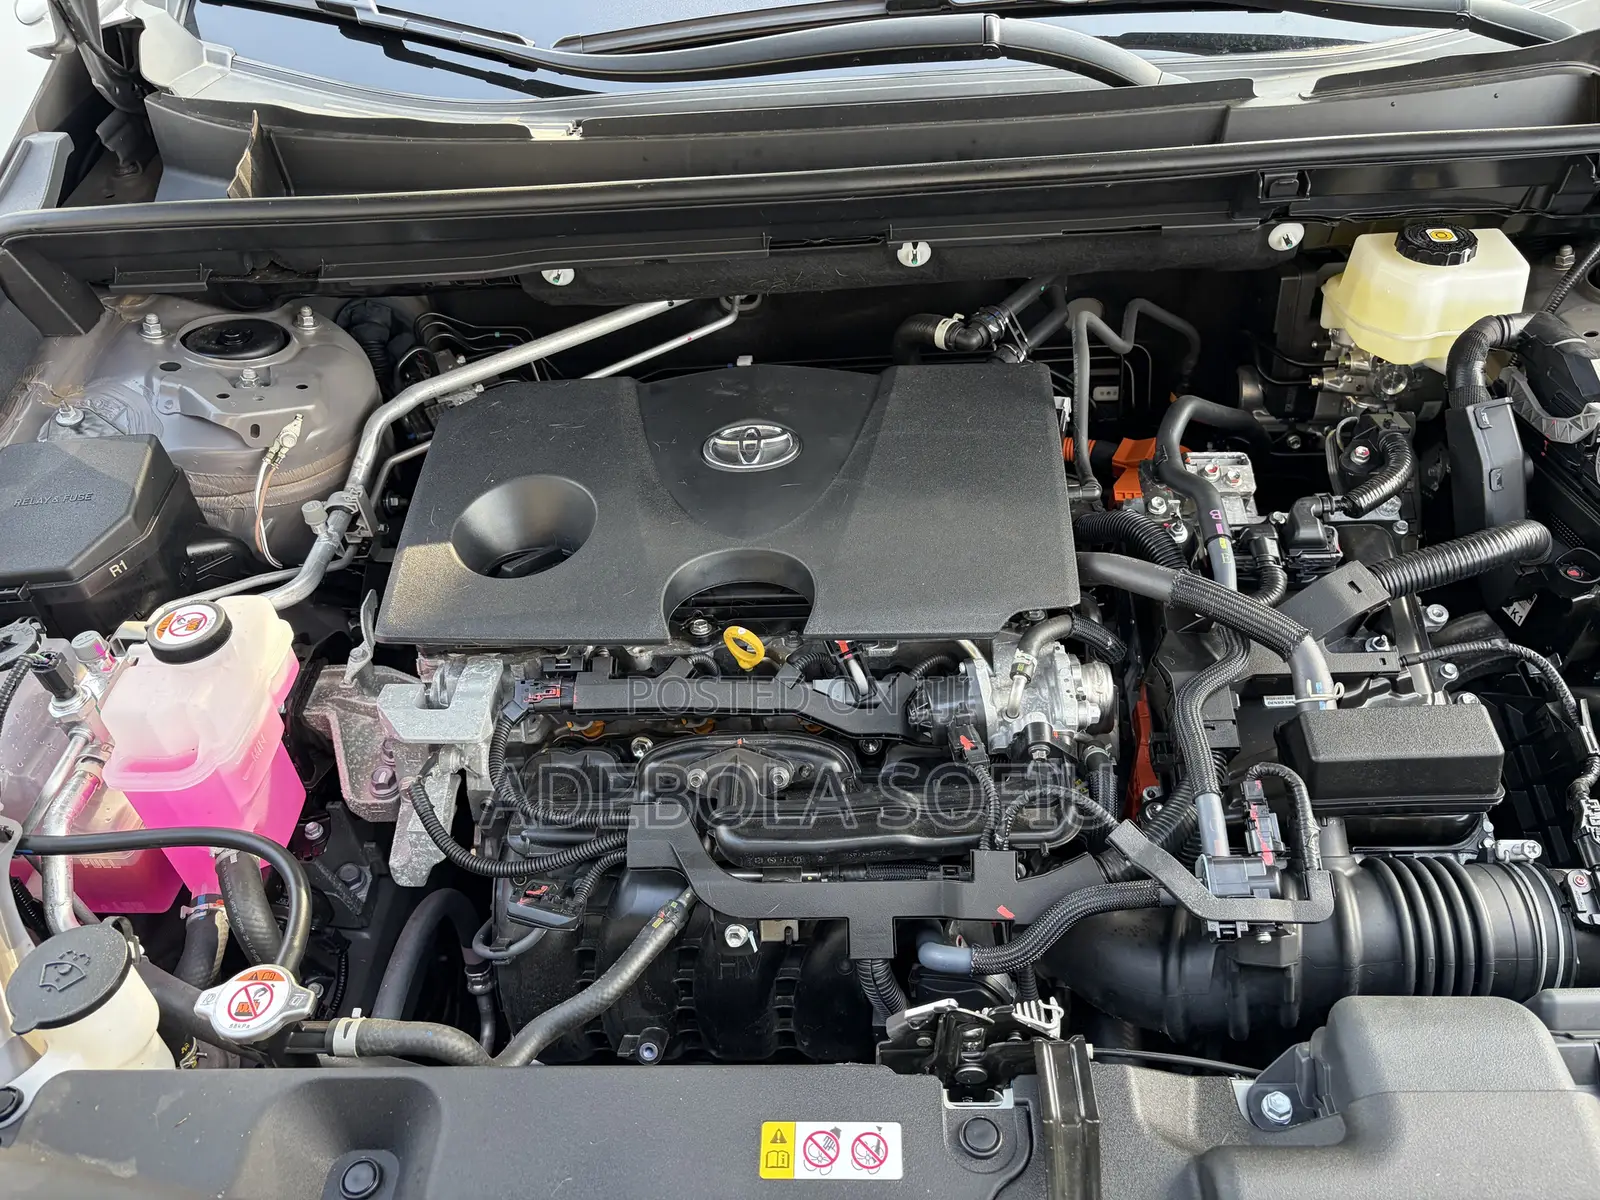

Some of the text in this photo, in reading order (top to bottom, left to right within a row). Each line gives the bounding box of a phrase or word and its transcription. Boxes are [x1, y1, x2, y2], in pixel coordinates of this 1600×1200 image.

[14, 495, 52, 507] RELAY
[62, 492, 94, 502] FUSE
[108, 559, 129, 578] R1
[79, 858, 122, 869] FULL
